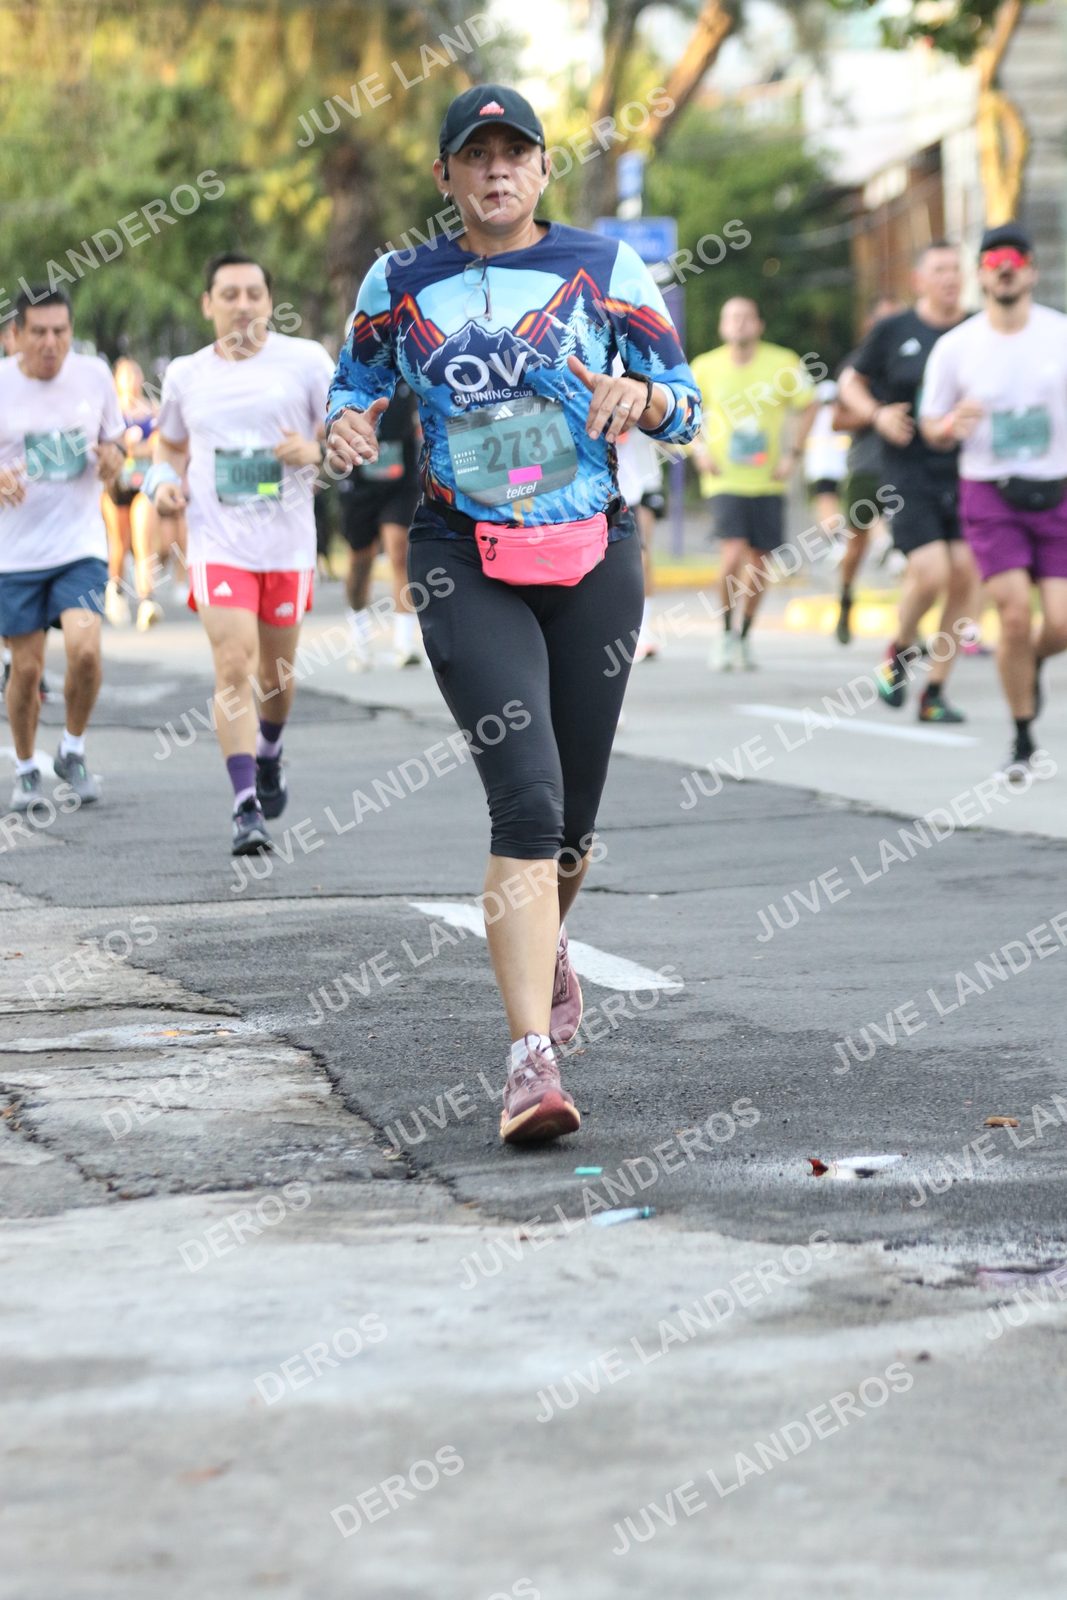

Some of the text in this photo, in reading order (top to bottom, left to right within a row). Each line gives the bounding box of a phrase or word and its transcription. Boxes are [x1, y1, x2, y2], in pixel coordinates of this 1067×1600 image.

[444, 351, 528, 392] OV
[455, 388, 533, 405] RUNNING CLUB
[482, 423, 570, 473] 2731
[506, 482, 537, 499] telcel
